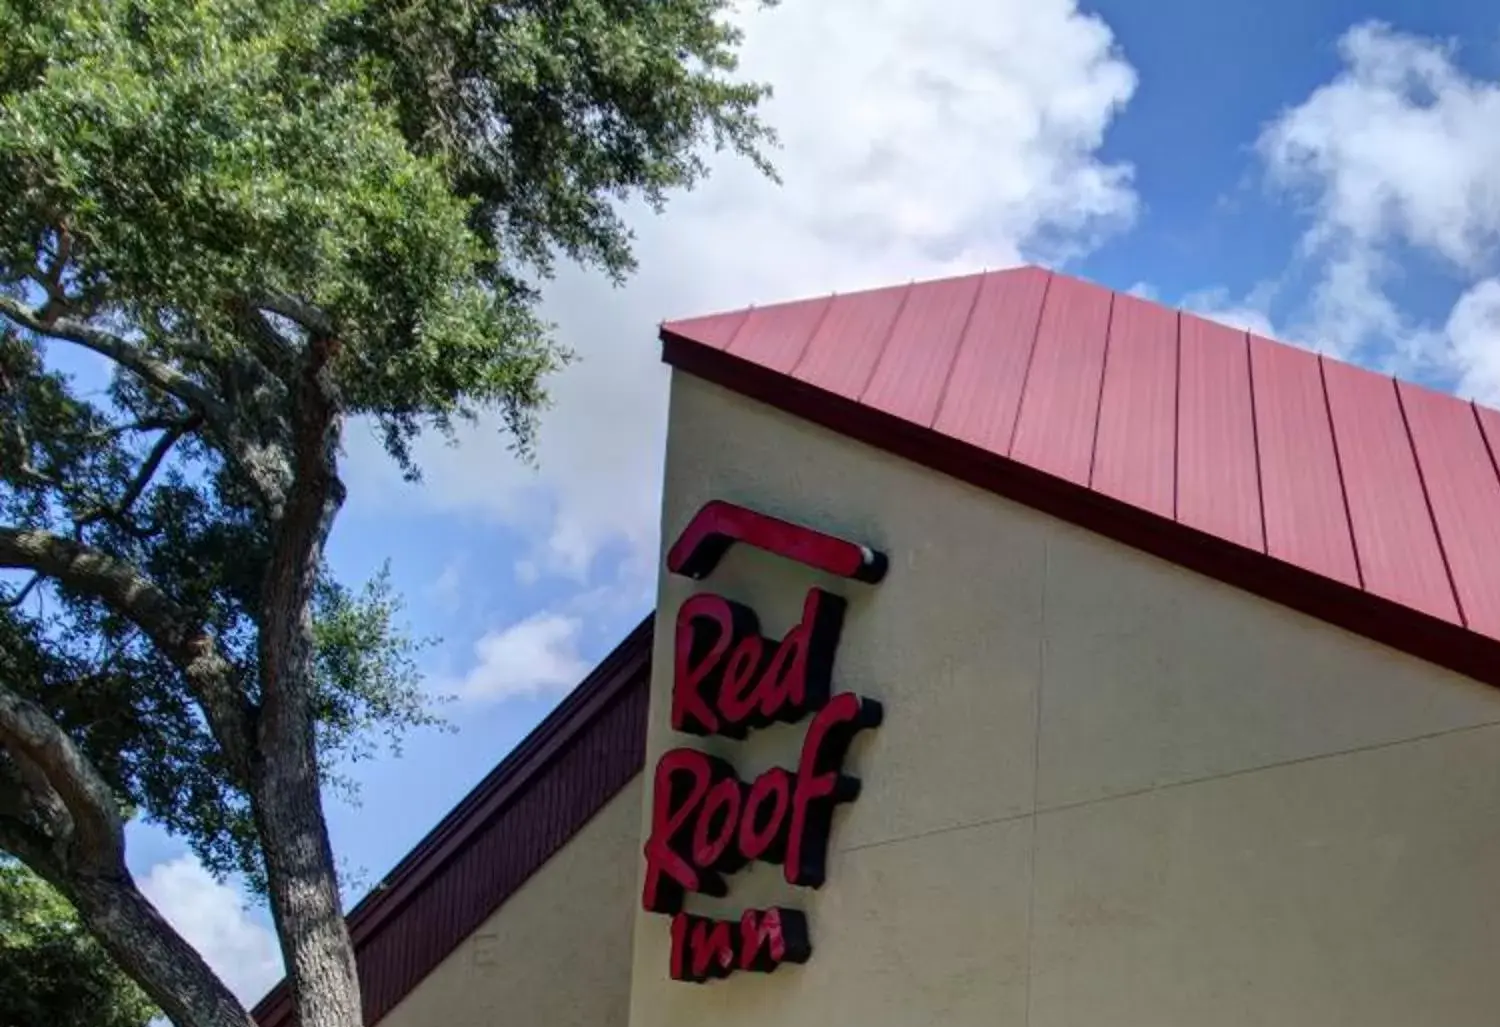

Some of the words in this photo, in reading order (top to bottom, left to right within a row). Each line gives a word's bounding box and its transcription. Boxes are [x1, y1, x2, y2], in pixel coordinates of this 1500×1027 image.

[672, 586, 840, 738] Red
[643, 691, 876, 912] Roof
[671, 907, 804, 982] Inn
